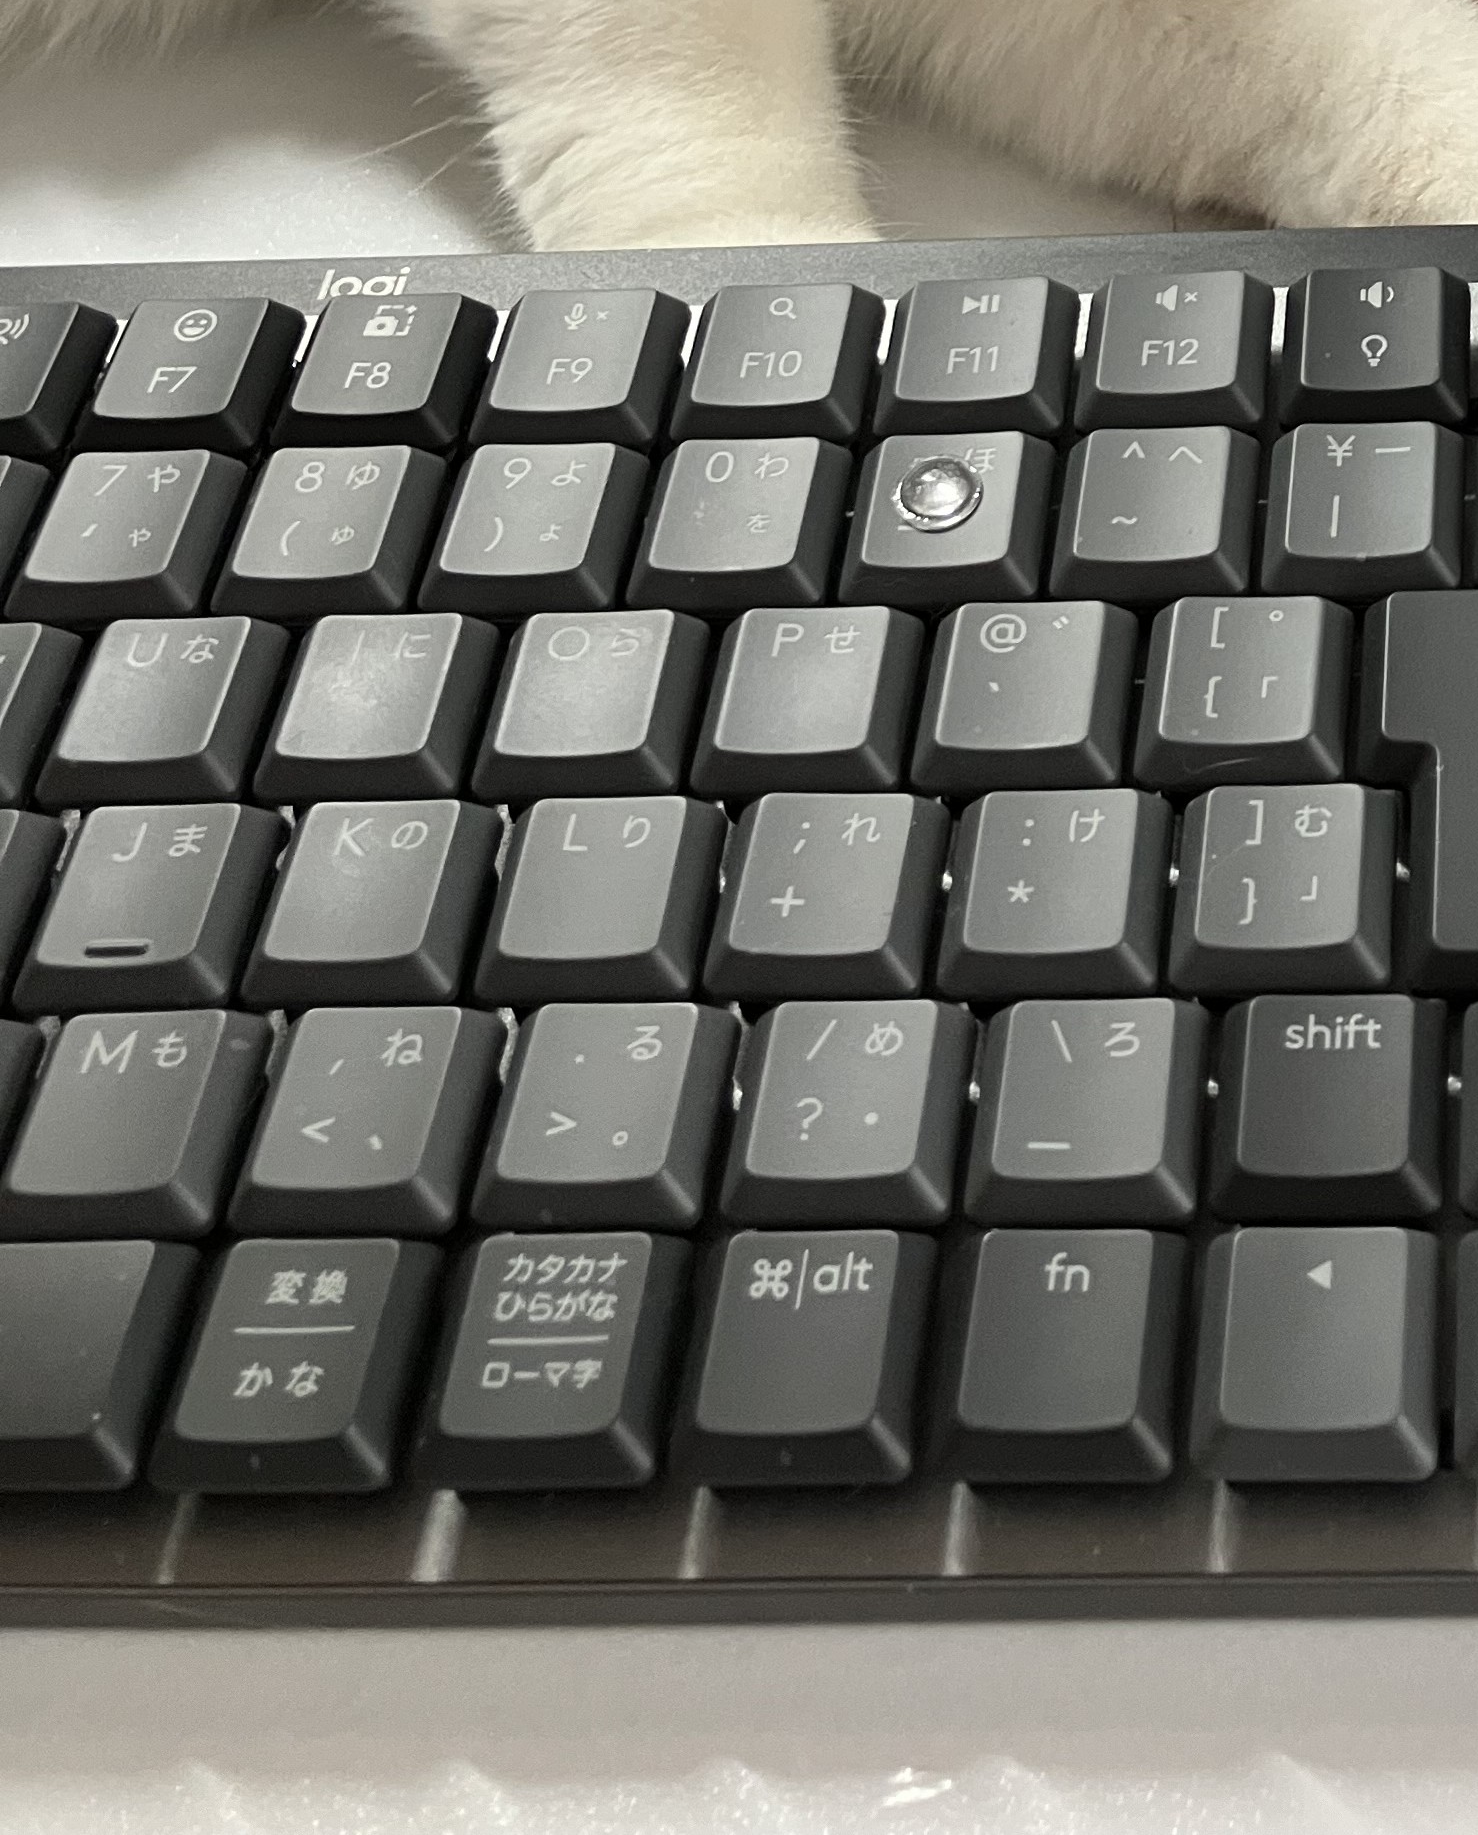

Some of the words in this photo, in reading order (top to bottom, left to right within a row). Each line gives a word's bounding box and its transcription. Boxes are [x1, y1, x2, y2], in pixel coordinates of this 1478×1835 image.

[739, 350, 803, 379] F10
[946, 345, 999, 374] F11
[1141, 338, 1199, 367] F12
[147, 366, 198, 393] F7
[344, 361, 392, 389] F8
[546, 357, 593, 385] F9
[94, 464, 128, 497] 7
[294, 461, 326, 493] 8
[503, 457, 532, 490] 9
[705, 451, 734, 483] 0
[124, 633, 168, 668] U
[180, 634, 220, 664] な
[771, 622, 805, 657] P
[824, 625, 861, 654] せ
[111, 822, 148, 863] J
[332, 818, 374, 857] K
[562, 813, 588, 852] L
[841, 812, 881, 846] れ
[1068, 808, 1106, 843] け
[380, 1028, 423, 1067] ね
[626, 1025, 663, 1061] る
[864, 1020, 904, 1056] め
[1104, 1021, 1140, 1058] ろ
[1284, 1013, 1382, 1050] shift
[80, 1029, 139, 1074] M
[152, 1031, 188, 1068] も
[503, 1252, 628, 1285] カタカナ
[1044, 1251, 1090, 1292] fn
[494, 1289, 618, 1322] ひらがな
